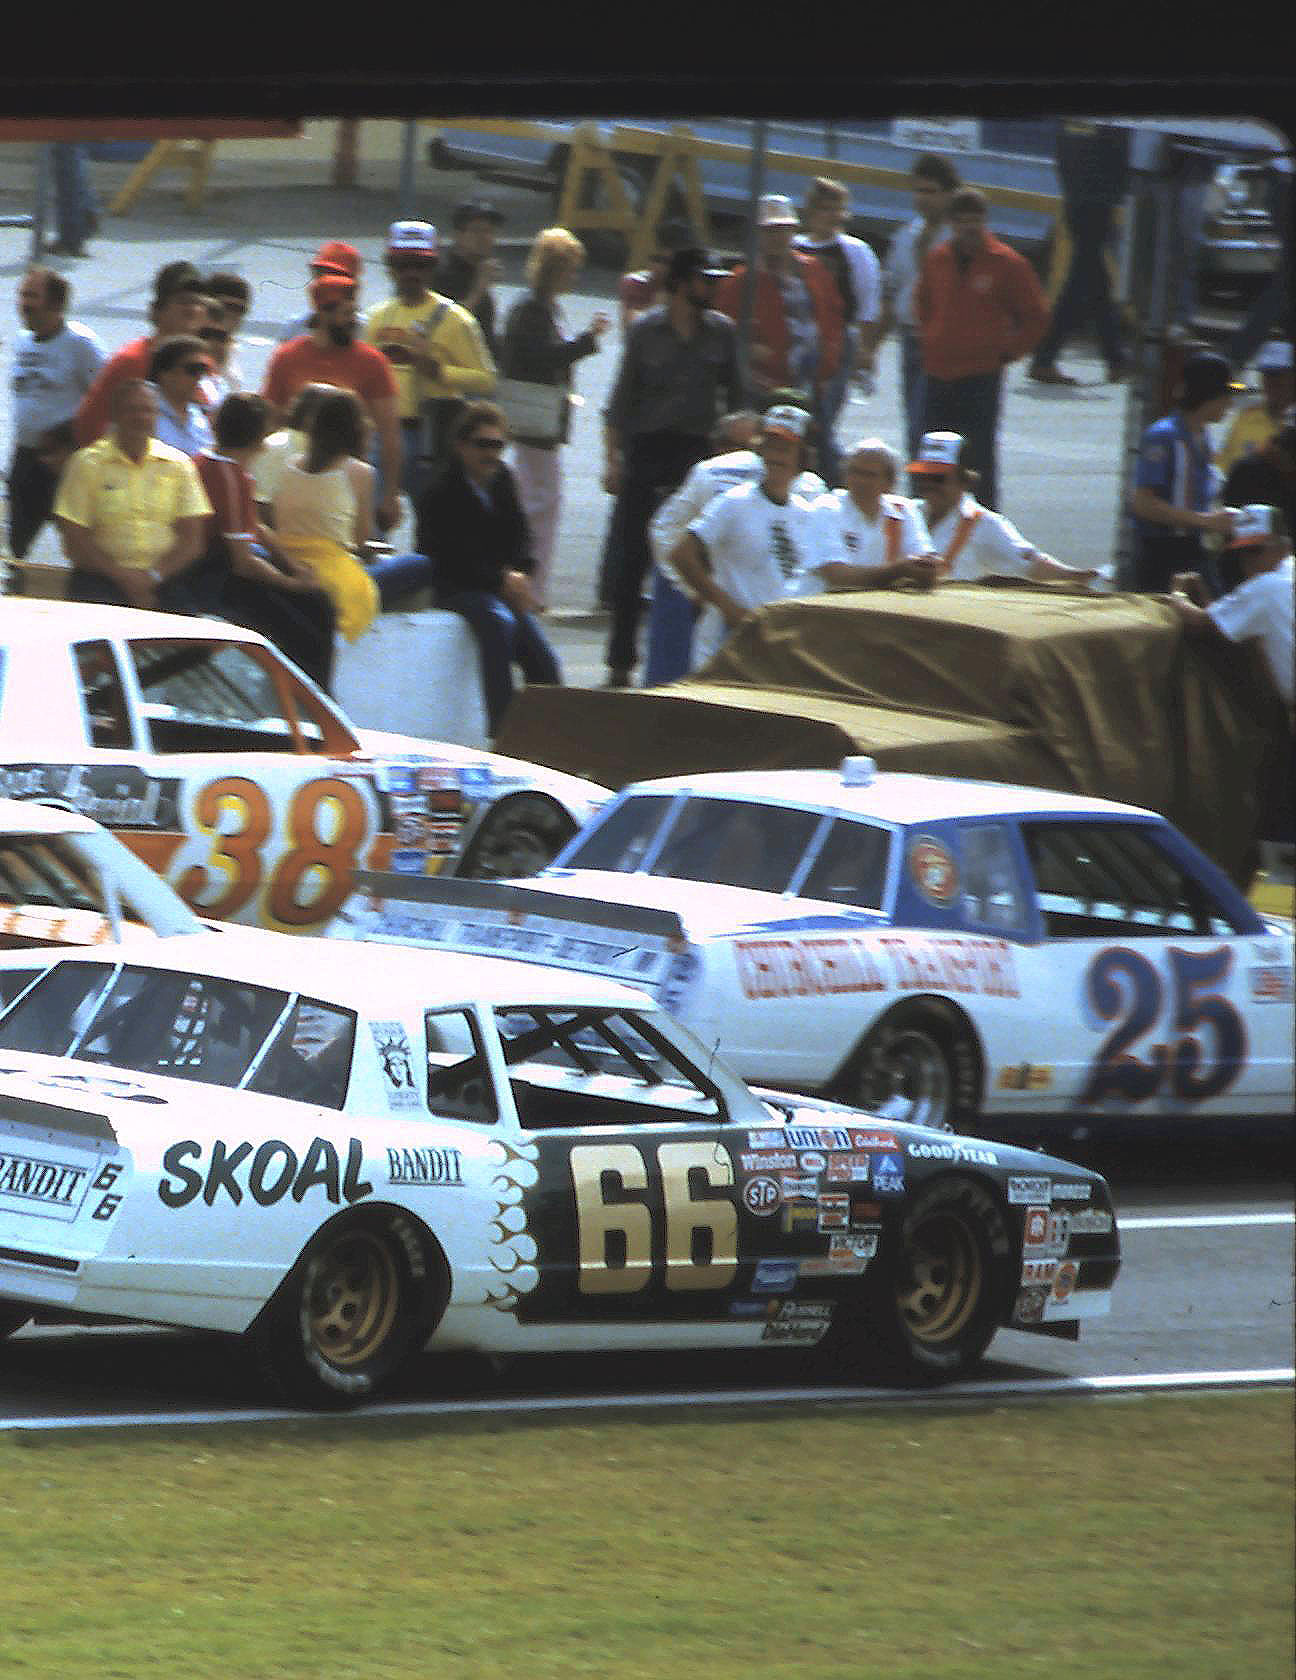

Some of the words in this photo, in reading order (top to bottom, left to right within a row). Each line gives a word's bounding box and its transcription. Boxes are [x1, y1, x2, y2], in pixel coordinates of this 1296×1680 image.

[176, 776, 368, 930] 38
[1078, 944, 1250, 1104] 25
[158, 1137, 374, 1208] SKOAL
[386, 1147, 464, 1183] BANDIT
[740, 1152, 798, 1171] Winston
[907, 1142, 1000, 1166] GOODYEAR
[569, 1141, 740, 1294] 66
[749, 1181, 778, 1207] STP
